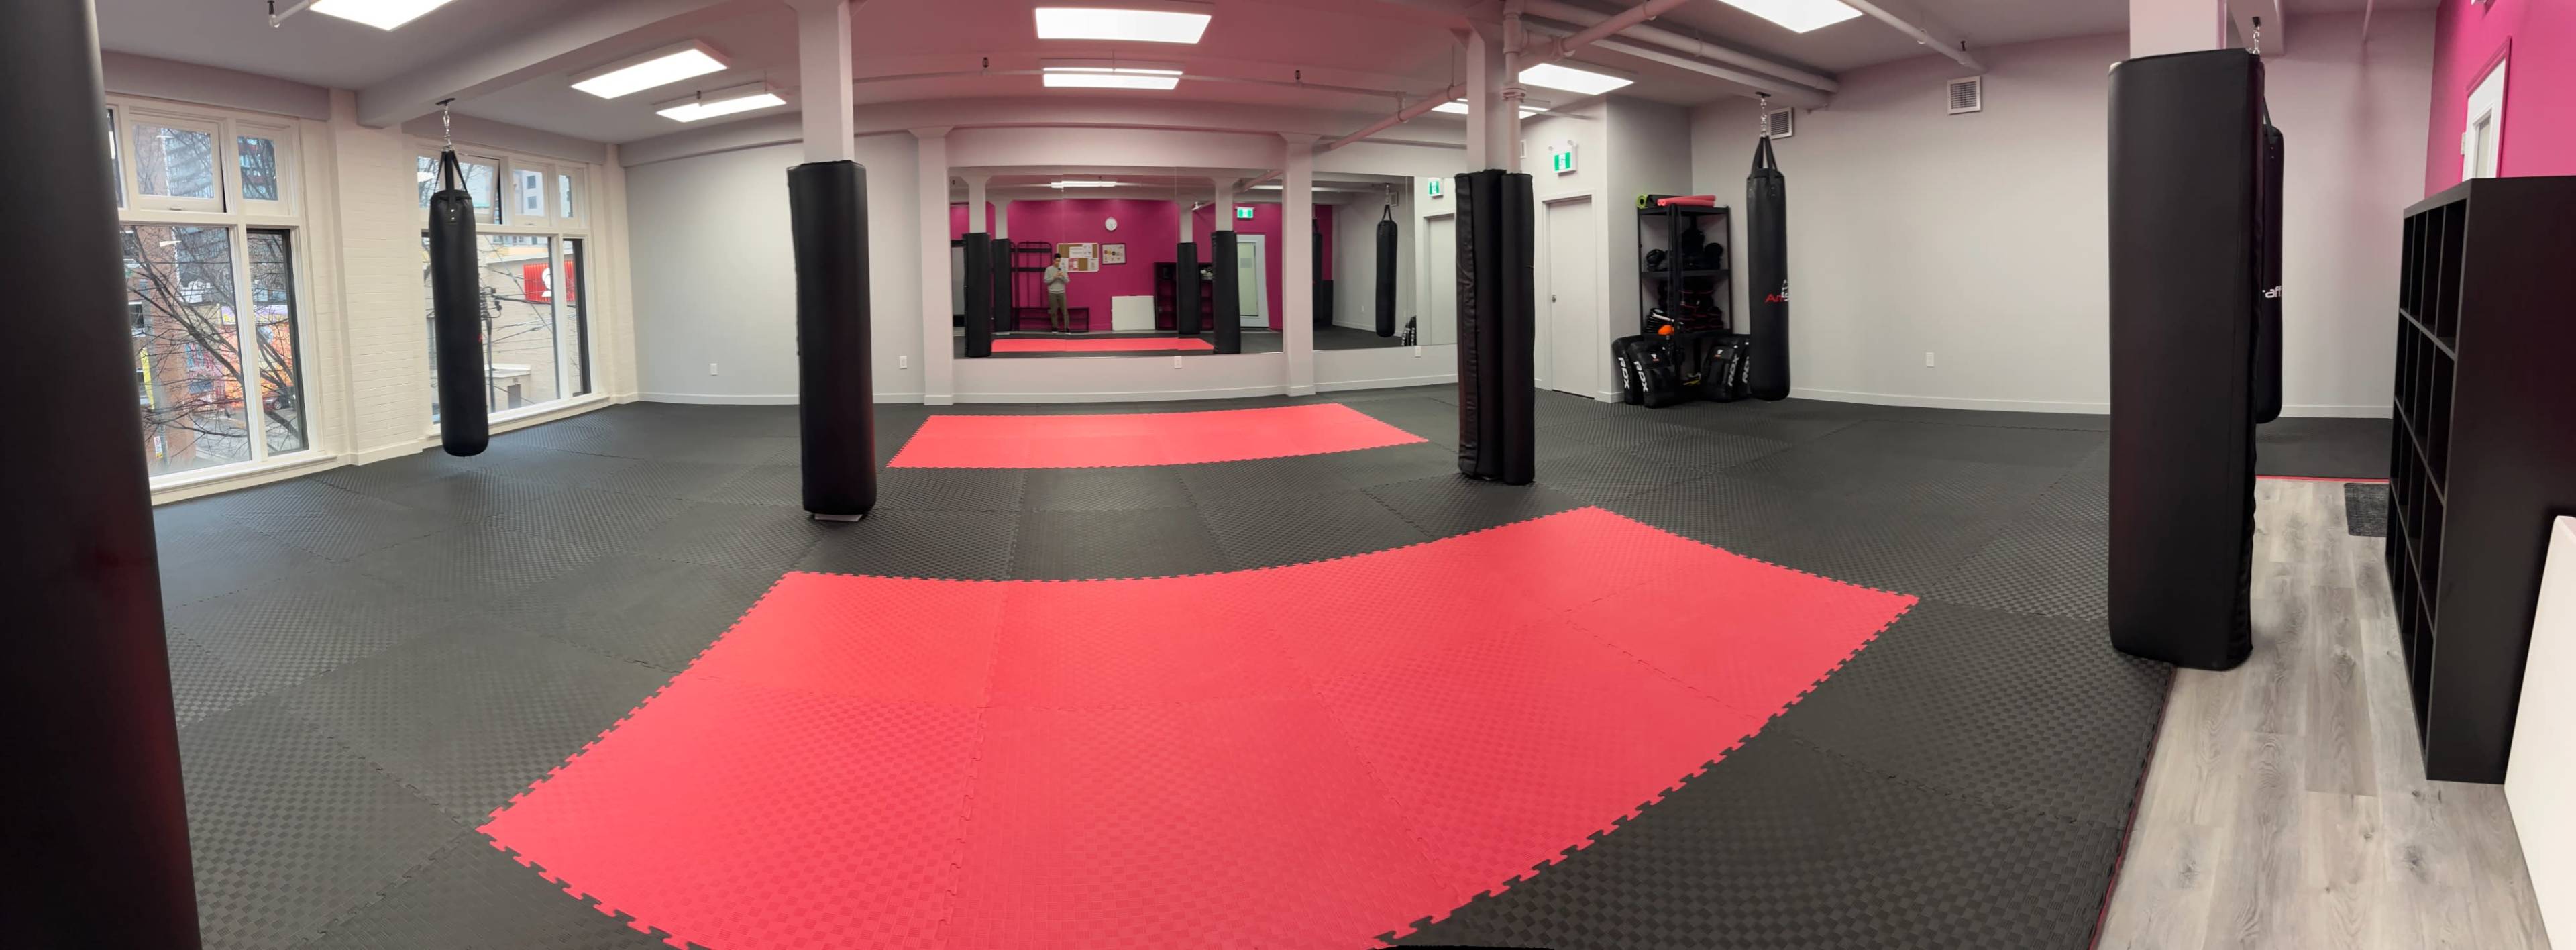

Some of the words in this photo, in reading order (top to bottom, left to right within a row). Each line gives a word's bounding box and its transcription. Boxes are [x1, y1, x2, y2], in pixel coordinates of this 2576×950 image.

[1617, 357, 1630, 389] RDX
[1633, 361, 1649, 392] RDX
[1727, 354, 1740, 386] RDX
